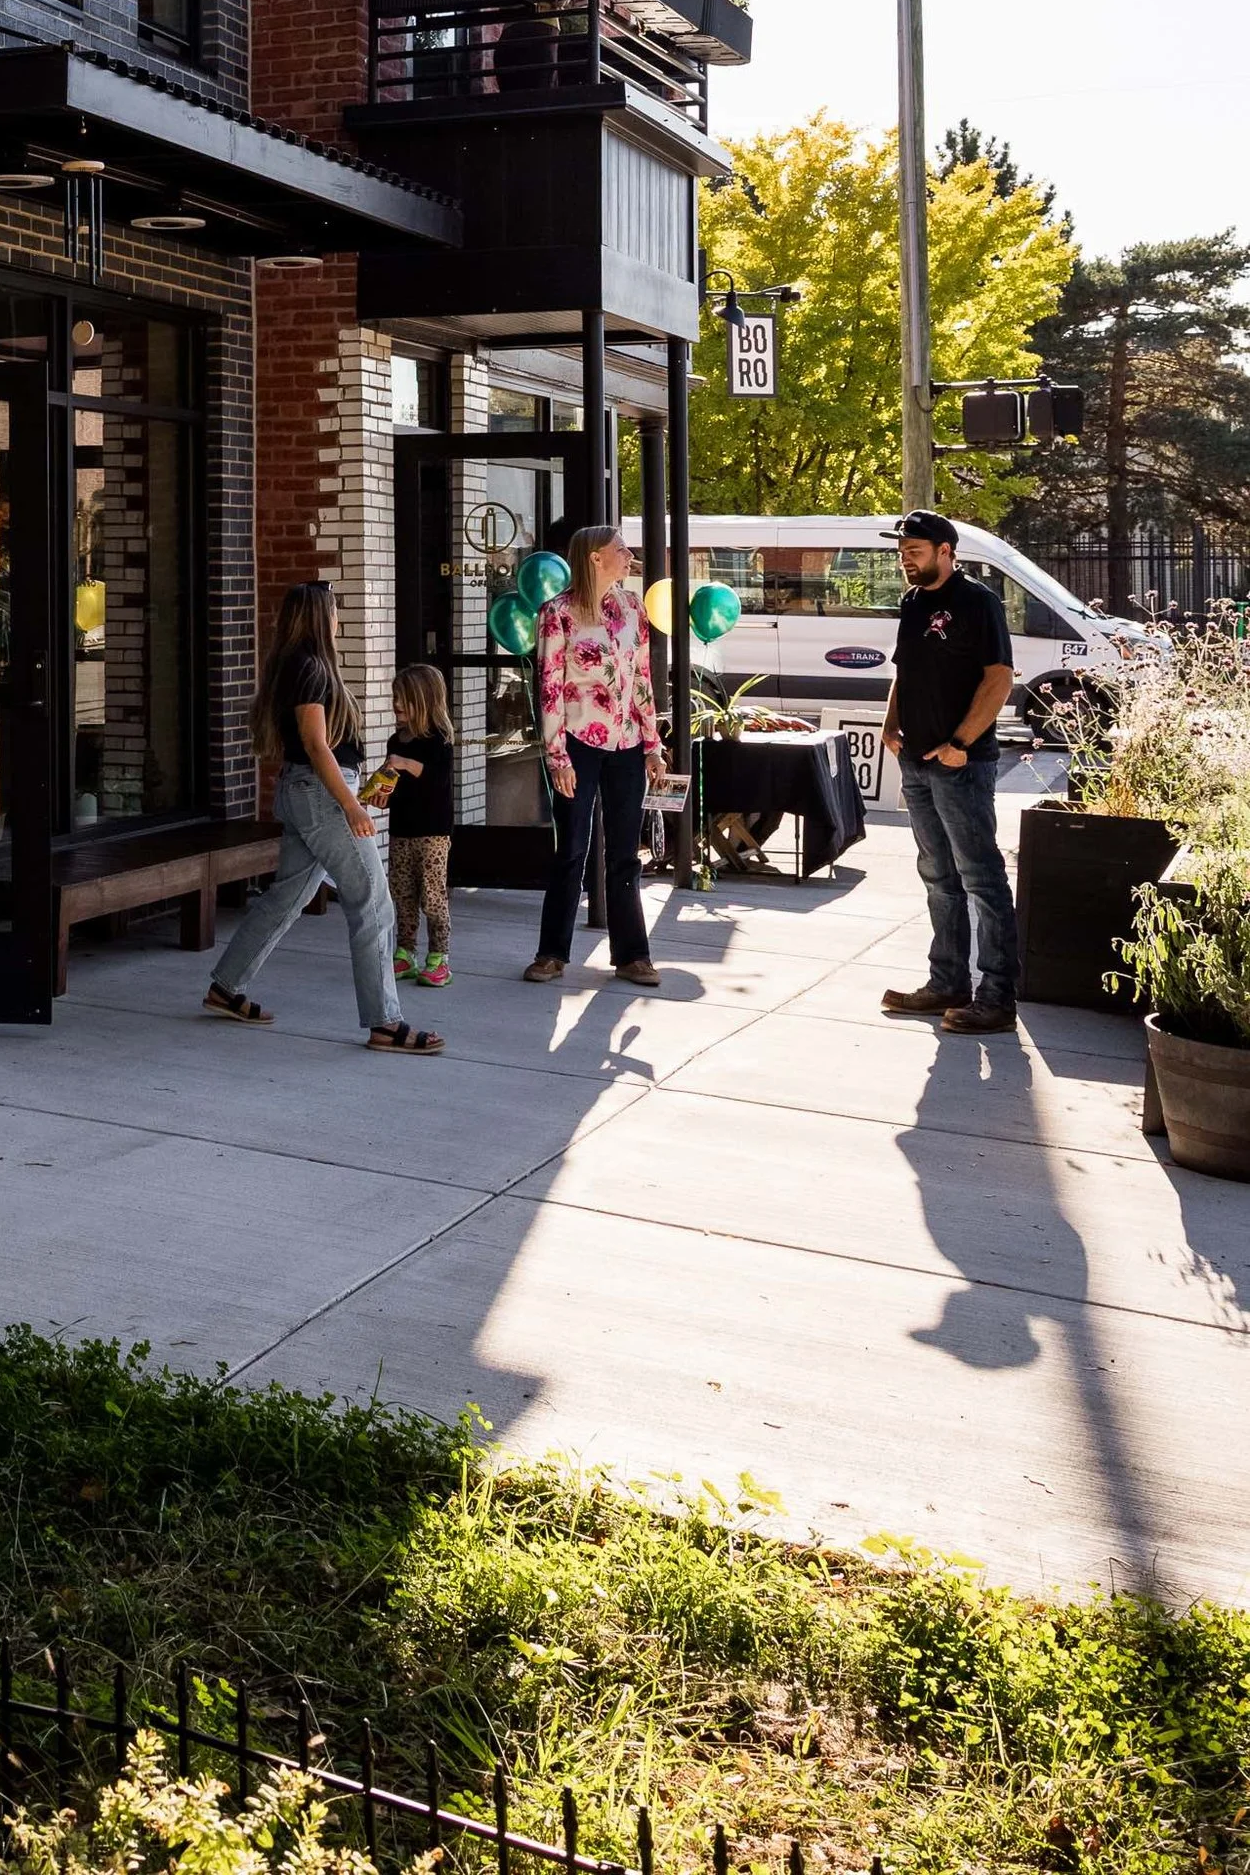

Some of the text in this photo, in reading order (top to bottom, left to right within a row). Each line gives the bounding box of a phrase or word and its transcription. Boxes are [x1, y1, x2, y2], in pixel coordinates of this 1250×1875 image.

[738, 324, 768, 354] BO
[738, 357, 768, 387] RO
[440, 563, 516, 577] BALLPOI
[1064, 644, 1086, 655] 647
[848, 731, 875, 759] BO
[851, 762, 872, 790] O
